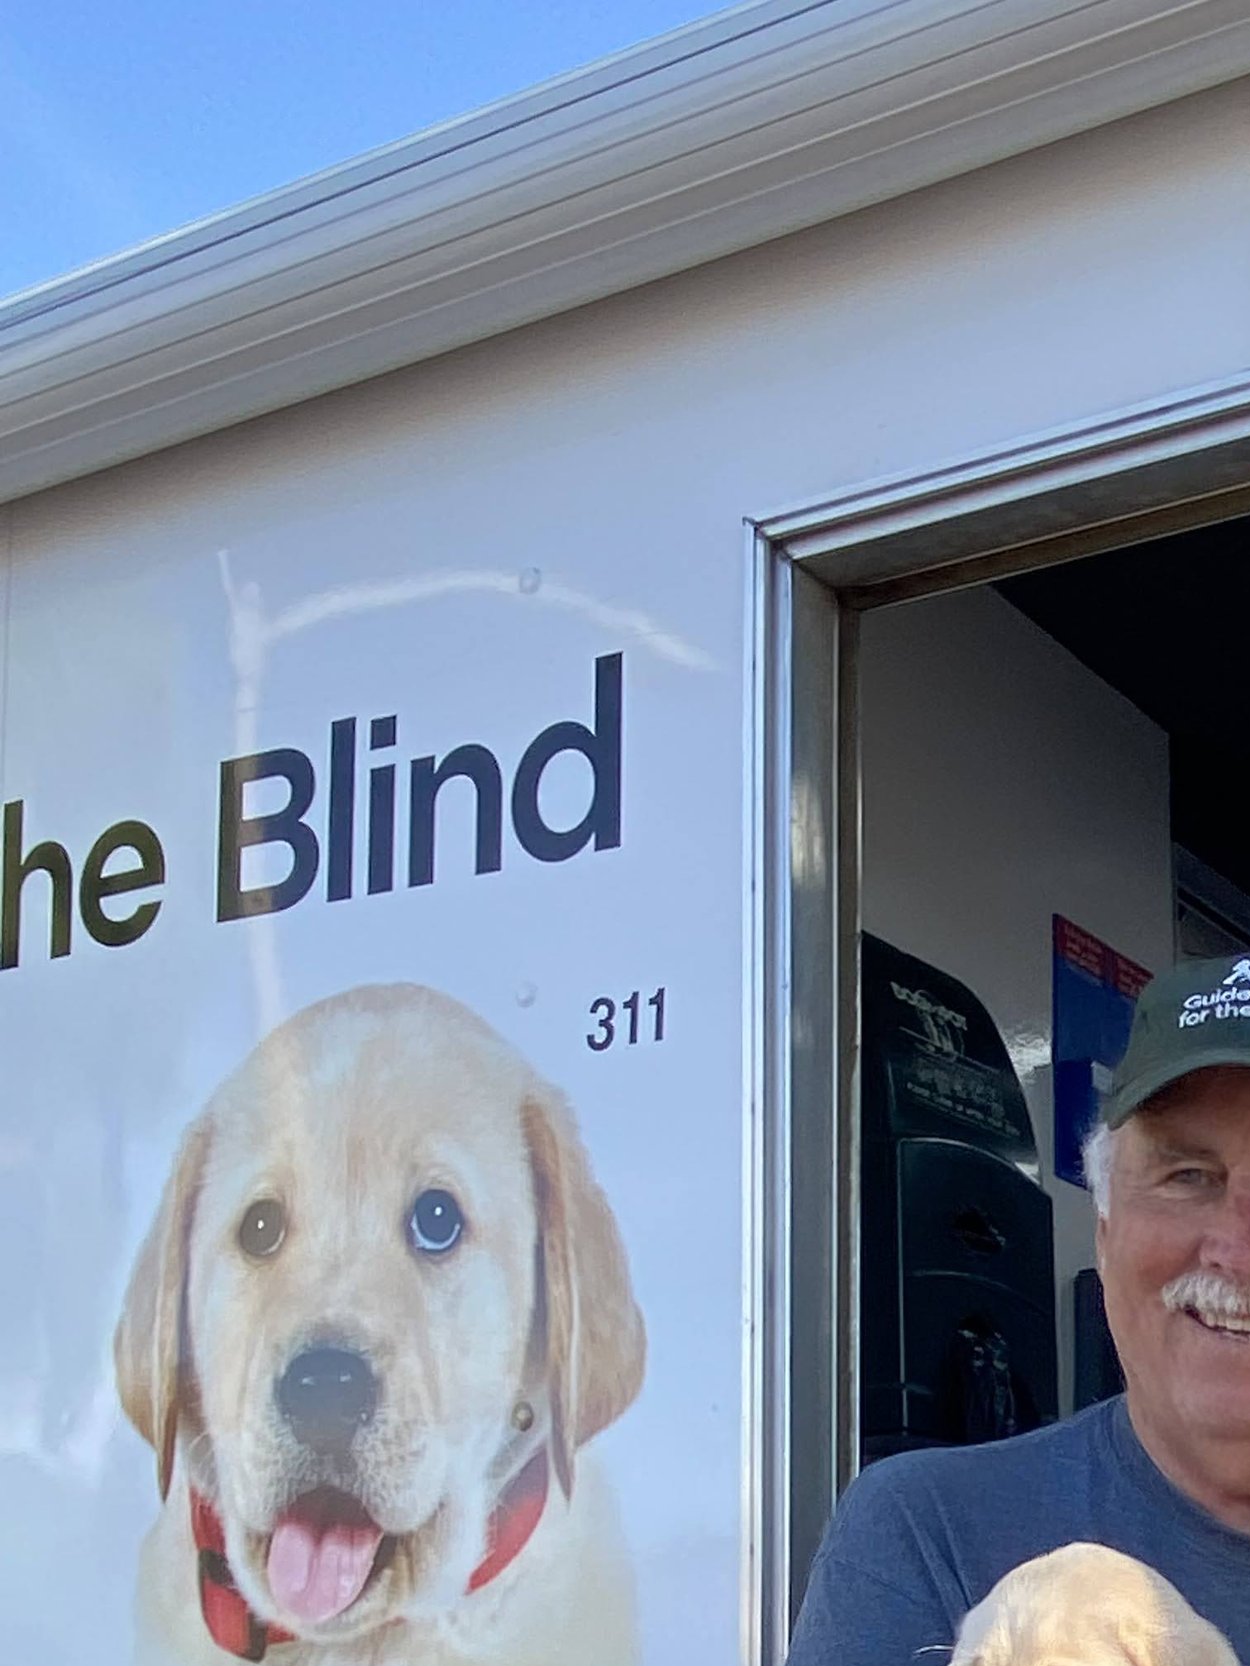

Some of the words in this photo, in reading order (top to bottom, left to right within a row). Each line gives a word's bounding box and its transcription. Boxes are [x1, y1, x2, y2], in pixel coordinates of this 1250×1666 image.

[0, 799, 166, 971] he
[215, 651, 623, 923] Blind
[586, 988, 666, 1052] 311
[1178, 1008, 1209, 1029] for
